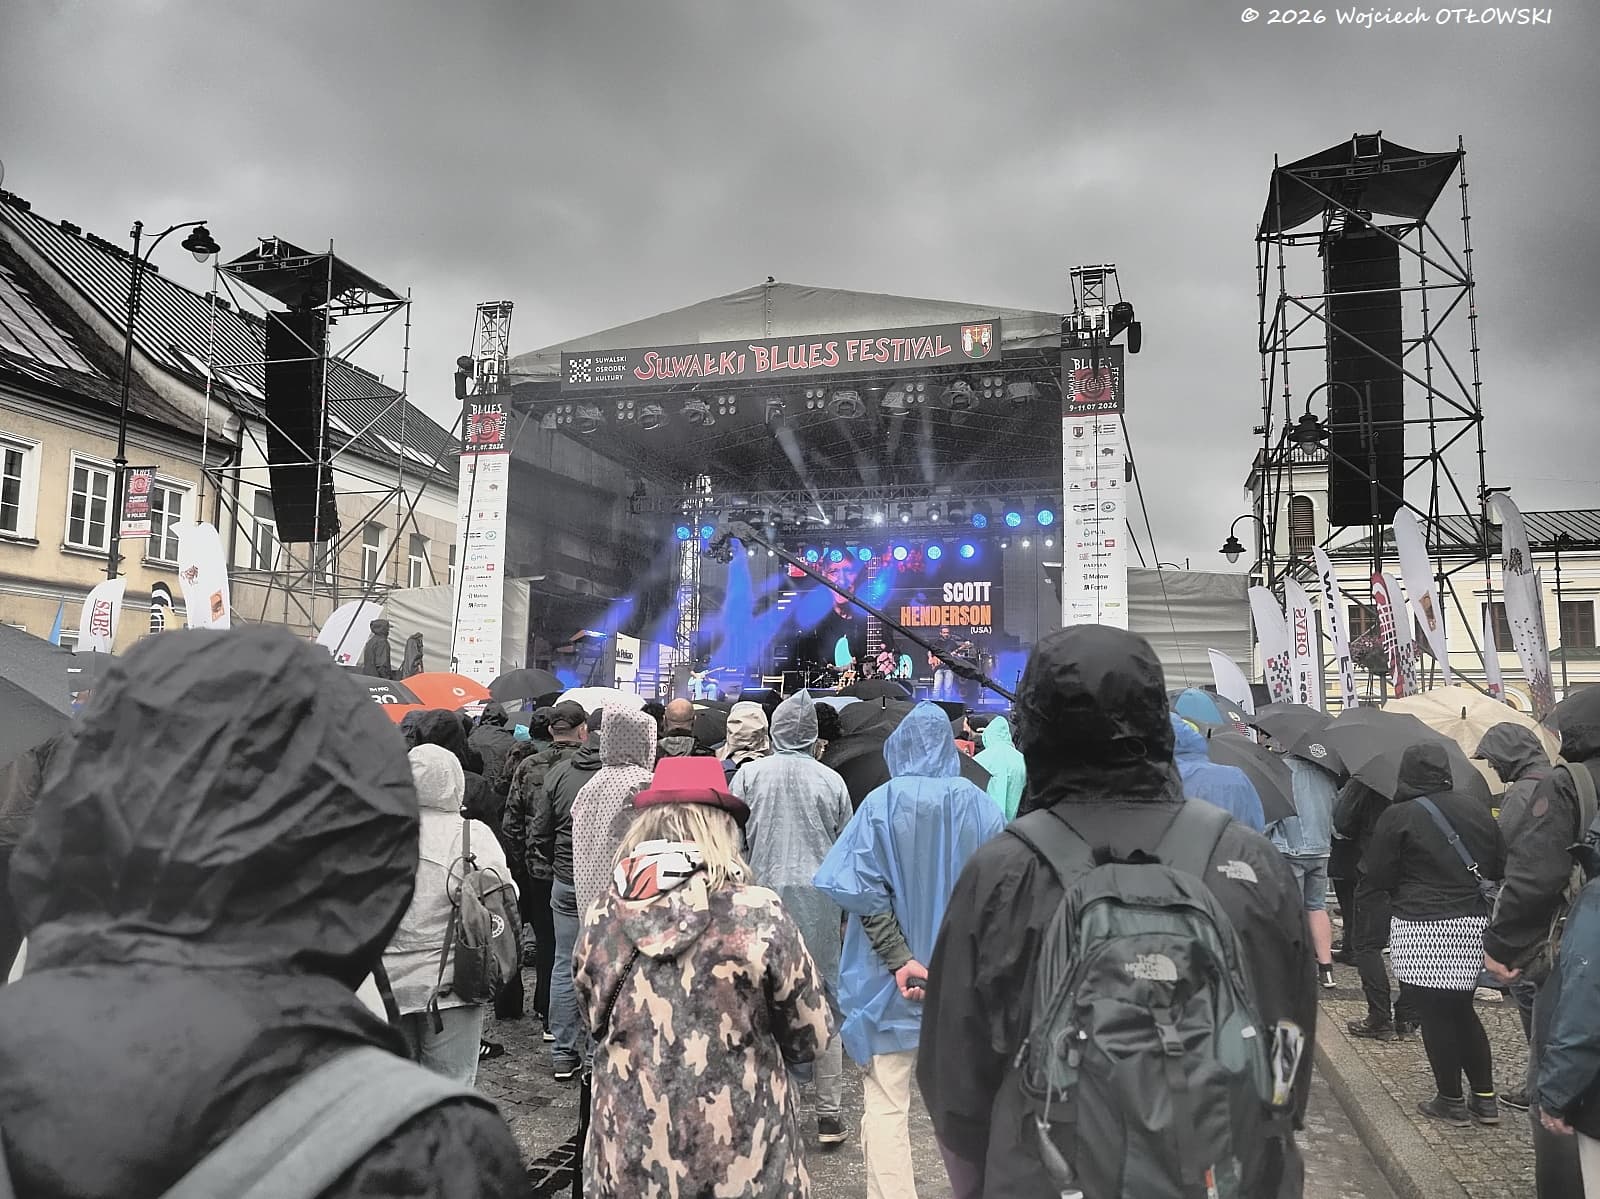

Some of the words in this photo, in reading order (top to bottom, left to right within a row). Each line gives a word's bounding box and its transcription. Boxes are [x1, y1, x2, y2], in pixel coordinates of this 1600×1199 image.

[595, 355, 627, 364] SUWALSKI
[633, 351, 746, 381] SUWAŁKI
[748, 341, 840, 373] BLUES
[846, 335, 952, 363] FESTIVAL
[595, 374, 624, 382] KULTURY
[470, 403, 502, 415] BLUES
[942, 581, 992, 603] SCOTT
[900, 604, 992, 627] HENDERSON
[970, 626, 992, 635] (USA)
